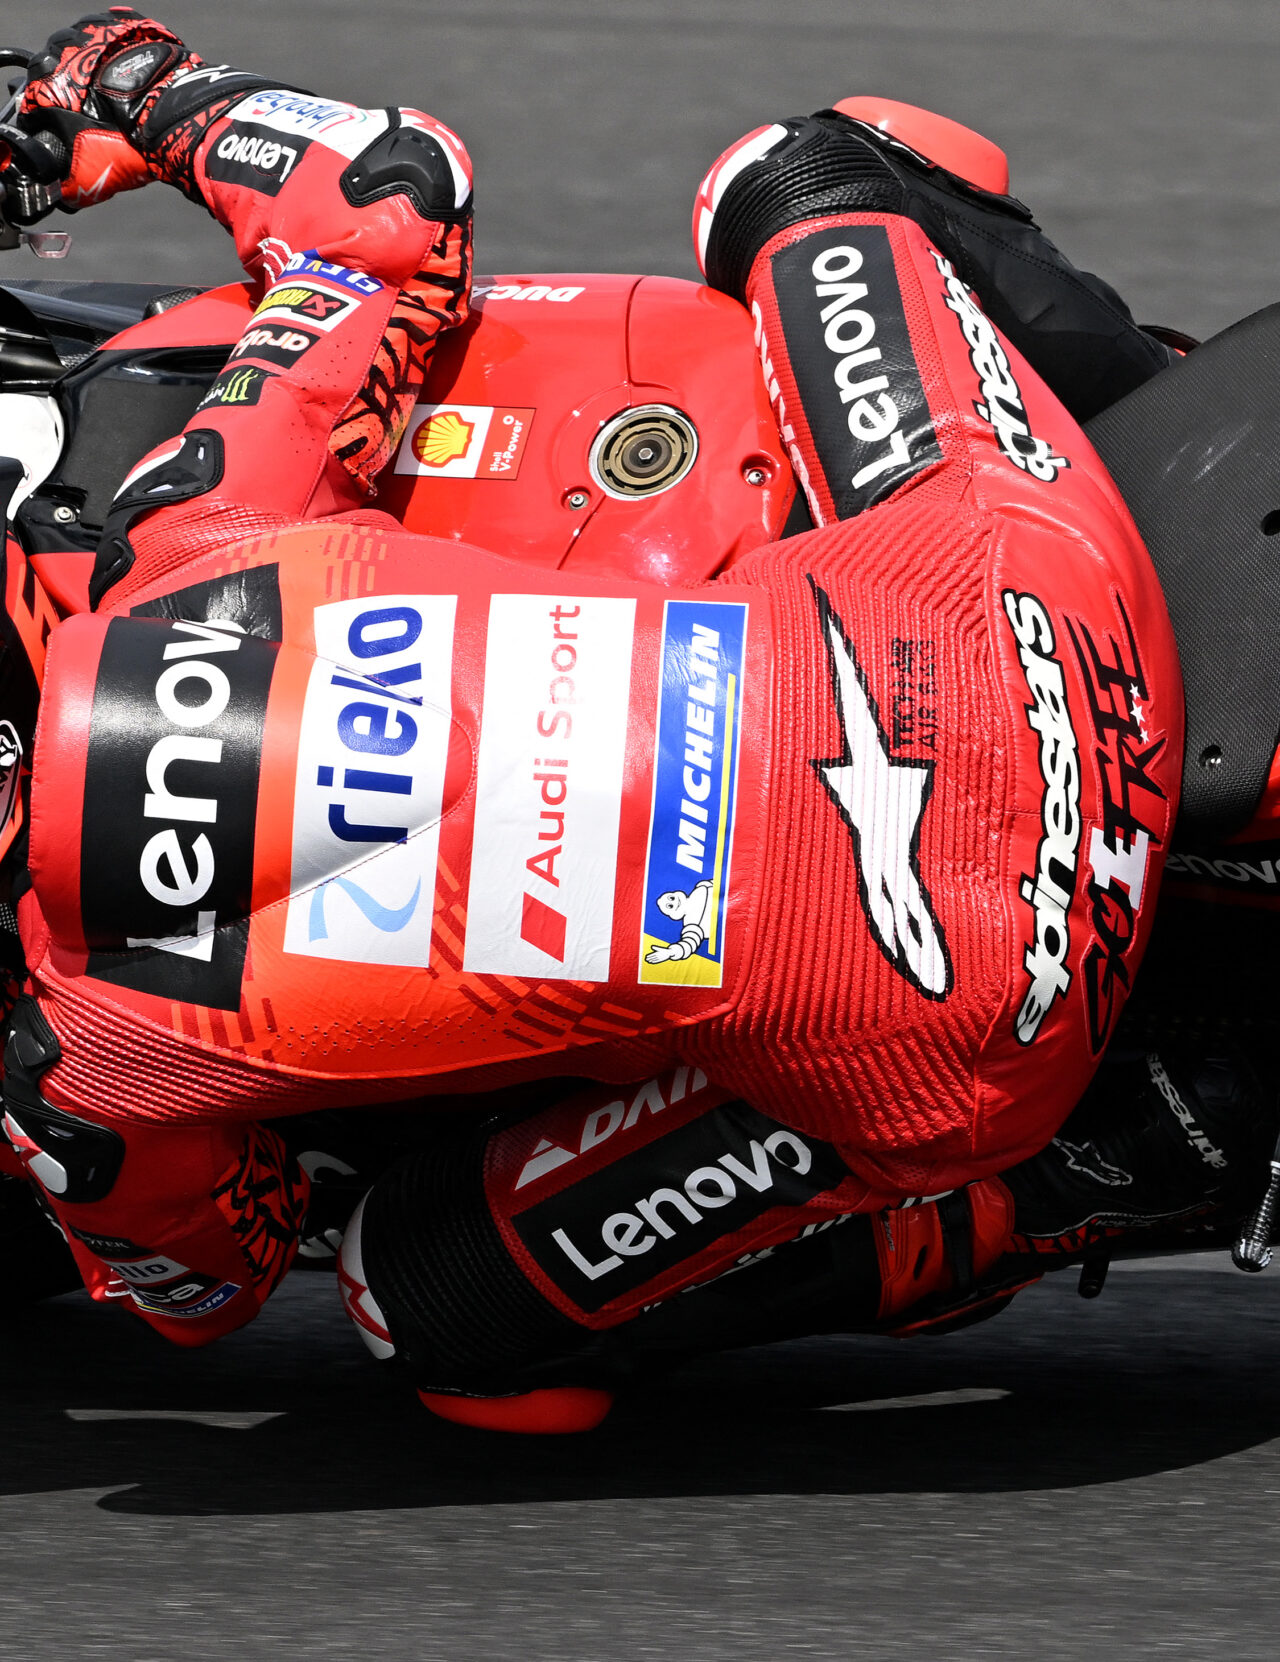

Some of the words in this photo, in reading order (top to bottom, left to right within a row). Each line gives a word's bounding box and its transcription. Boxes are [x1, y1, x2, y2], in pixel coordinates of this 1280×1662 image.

[217, 134, 297, 183] Lenovo
[472, 285, 587, 302] DUCA
[811, 244, 913, 490] Lenovo
[489, 451, 503, 472] Shell
[536, 603, 581, 740] Sport
[126, 618, 250, 963] Lenov
[676, 622, 721, 875] MICHELIN
[525, 754, 570, 888] Audi
[1002, 589, 1080, 1046] alpinestars
[1164, 852, 1280, 884] enov
[550, 1130, 813, 1281] Lenovo
